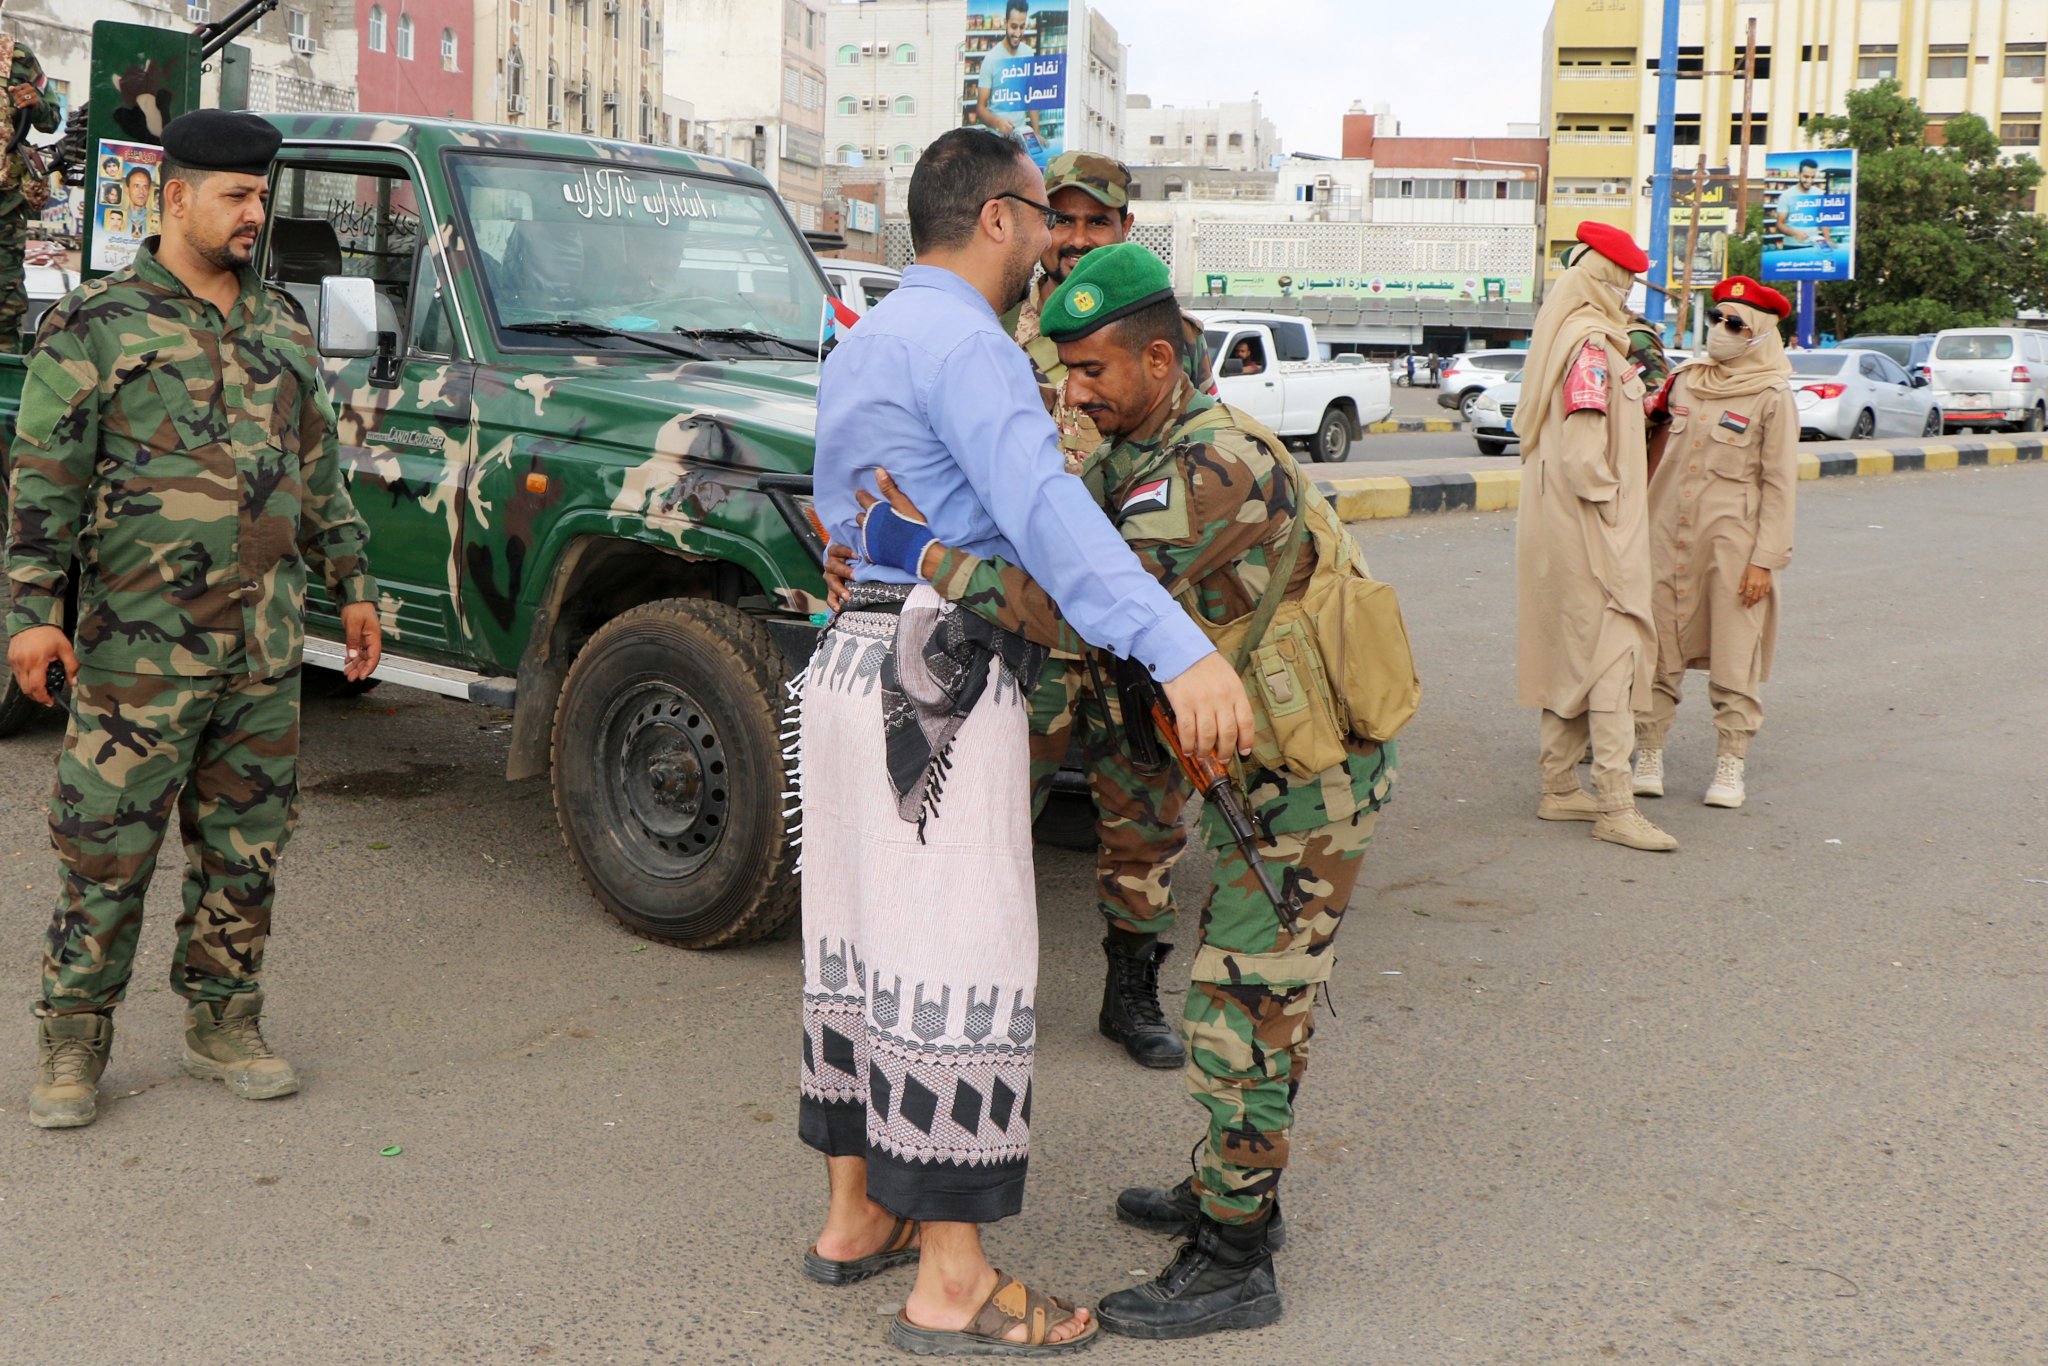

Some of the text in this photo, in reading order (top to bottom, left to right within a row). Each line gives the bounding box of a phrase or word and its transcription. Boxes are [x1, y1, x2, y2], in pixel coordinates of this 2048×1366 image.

[1000, 60, 1059, 84] نقاط الدفع
[992, 84, 1058, 105] تسهل حياتك
[1795, 197, 1846, 211] نقاط الدفع
[1788, 211, 1846, 223] تسهل حياتك
[1416, 279, 1455, 292] مطعم
